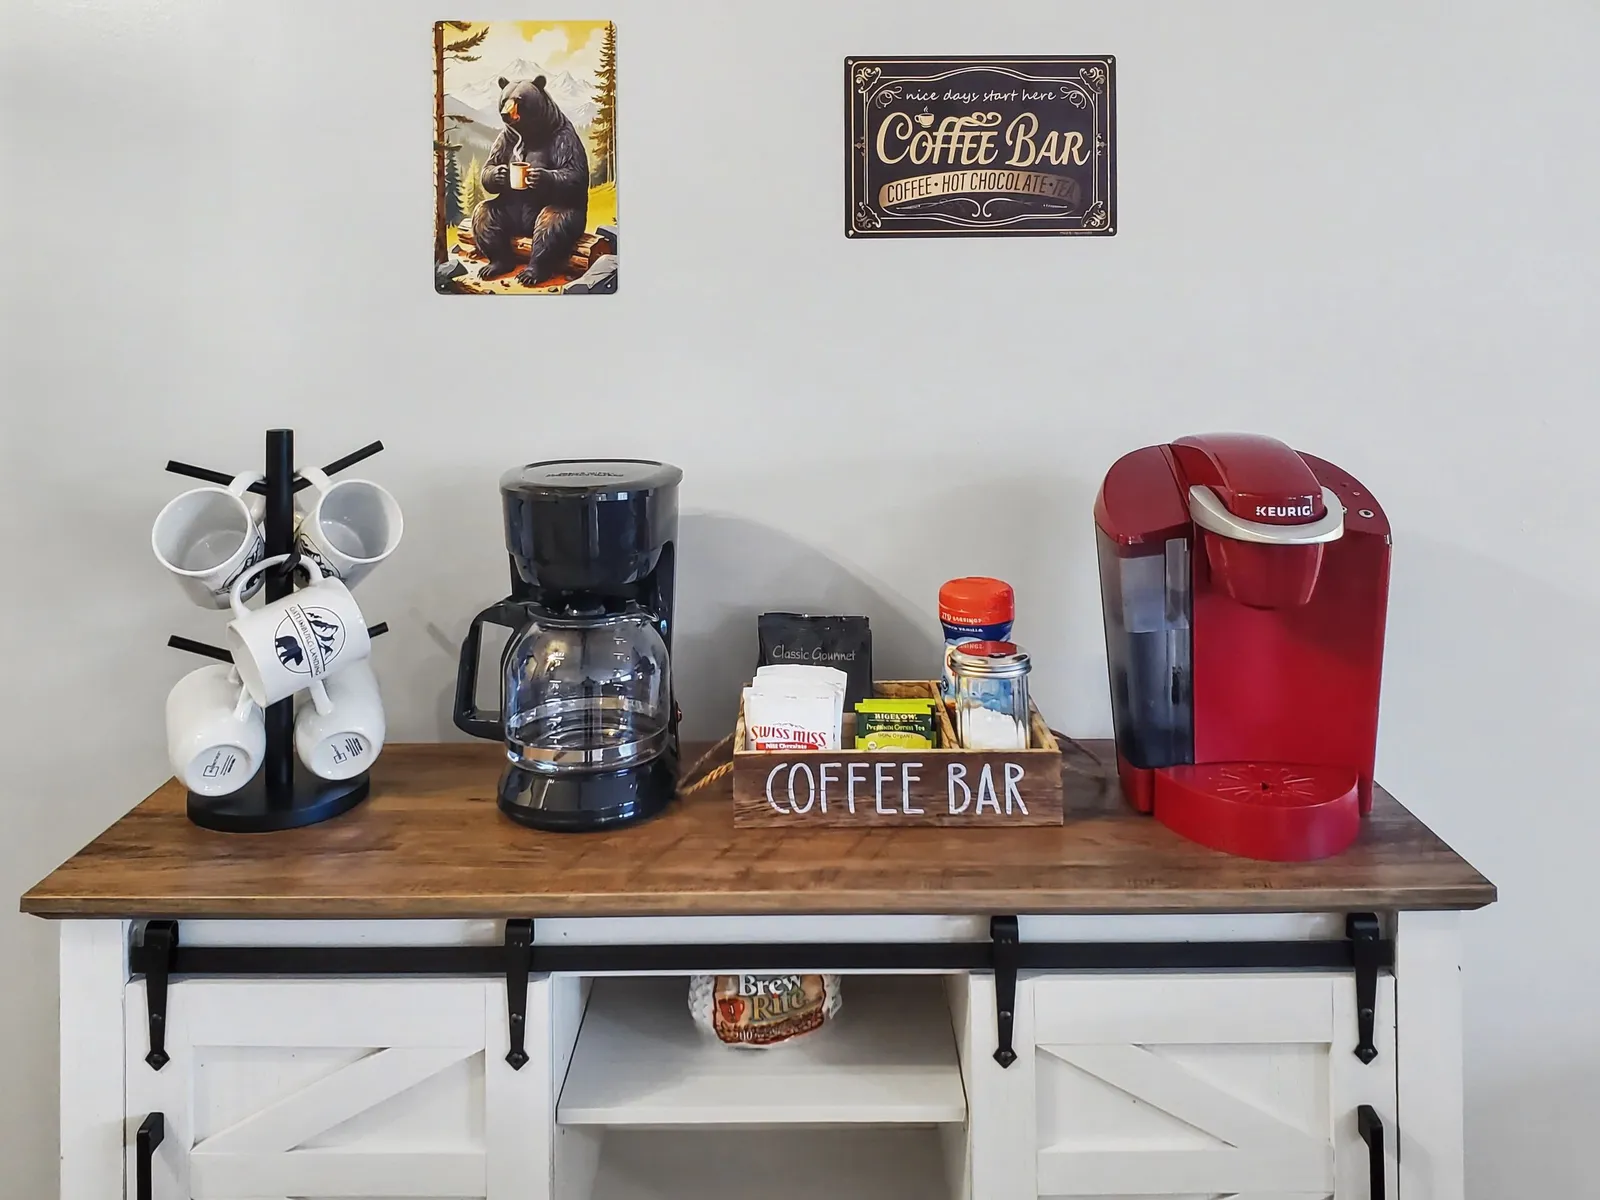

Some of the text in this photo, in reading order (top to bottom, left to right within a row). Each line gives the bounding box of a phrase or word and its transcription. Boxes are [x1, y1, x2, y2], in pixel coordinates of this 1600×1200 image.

[906, 87, 1057, 104] nice days start here
[887, 171, 1076, 203] COFFEE HOT CHOCOLATE TEA
[1256, 506, 1312, 517] KEURIG
[772, 644, 856, 661] Classic Gourmet
[750, 725, 827, 747] SWISS MISS
[765, 762, 1029, 816] COFFEE BAR
[738, 974, 801, 996] Brew
[753, 990, 806, 1021] Rite
